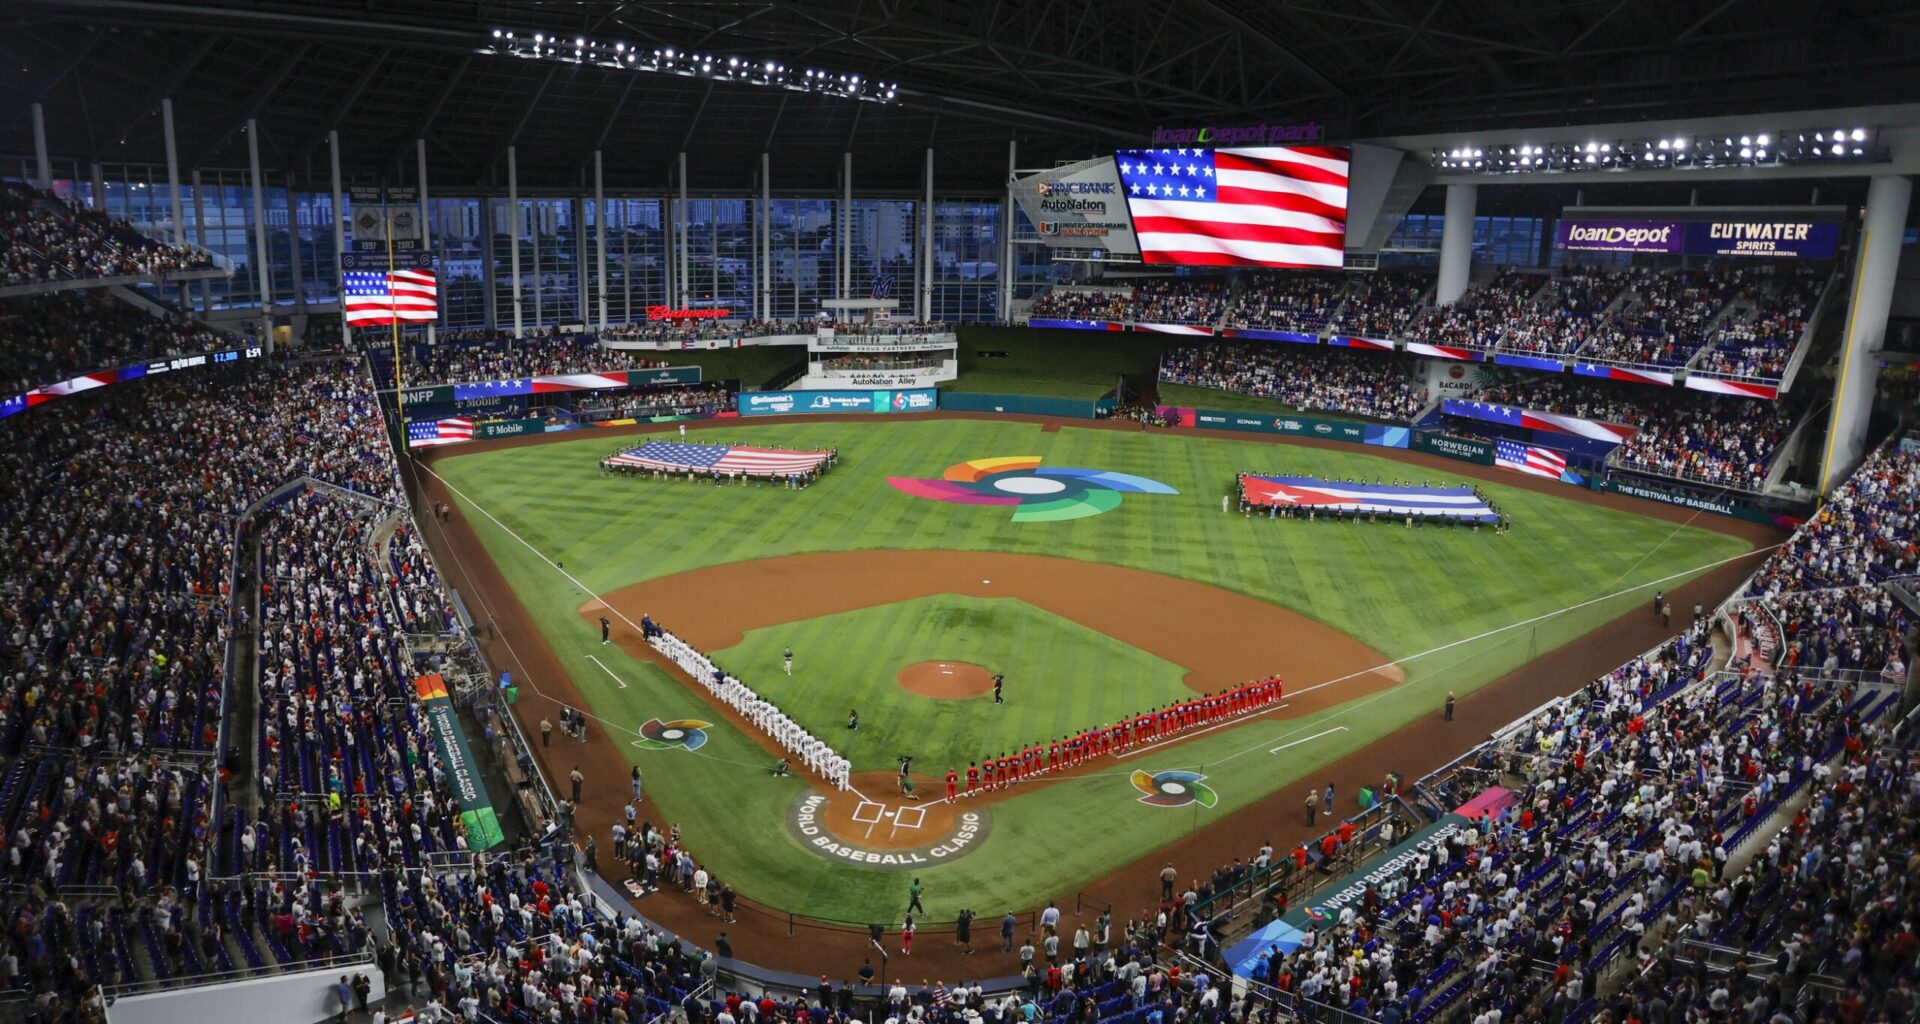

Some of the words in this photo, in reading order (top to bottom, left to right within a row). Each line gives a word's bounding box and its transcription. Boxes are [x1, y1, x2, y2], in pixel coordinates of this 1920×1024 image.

[1155, 123, 1266, 144] loanDepot
[1269, 122, 1320, 144] park
[1041, 199, 1105, 210] AutoNation
[1569, 224, 1671, 246] loanDepot
[1710, 223, 1809, 240] CUTWATER
[361, 241, 377, 250] 1997
[397, 240, 415, 249] 2003
[1736, 241, 1776, 250] SPIRITS
[645, 305, 730, 320] Budweiser
[852, 378, 894, 386] AutoNation
[898, 377, 917, 386] Alley
[409, 390, 434, 403] NFP
[496, 423, 523, 434] Mobile
[1431, 438, 1484, 455] NORWEGIAN
[1440, 446, 1458, 455] CRUISE
[1618, 485, 1634, 495] THE
[1634, 488, 1672, 502] FESTIVAL
[1673, 496, 1685, 504] OF
[1686, 499, 1732, 514] BASEBALL
[436, 712, 453, 736] WORLD
[443, 735, 464, 769] BASEBALL
[455, 768, 477, 802] CLASSIC
[798, 795, 826, 836] WORLD
[812, 836, 927, 864] BASEBALL
[930, 813, 979, 858] CLASSIC
[1323, 880, 1368, 910] WORLD
[1365, 848, 1420, 885] BASEBALL
[1416, 823, 1457, 851] CLASSIC
